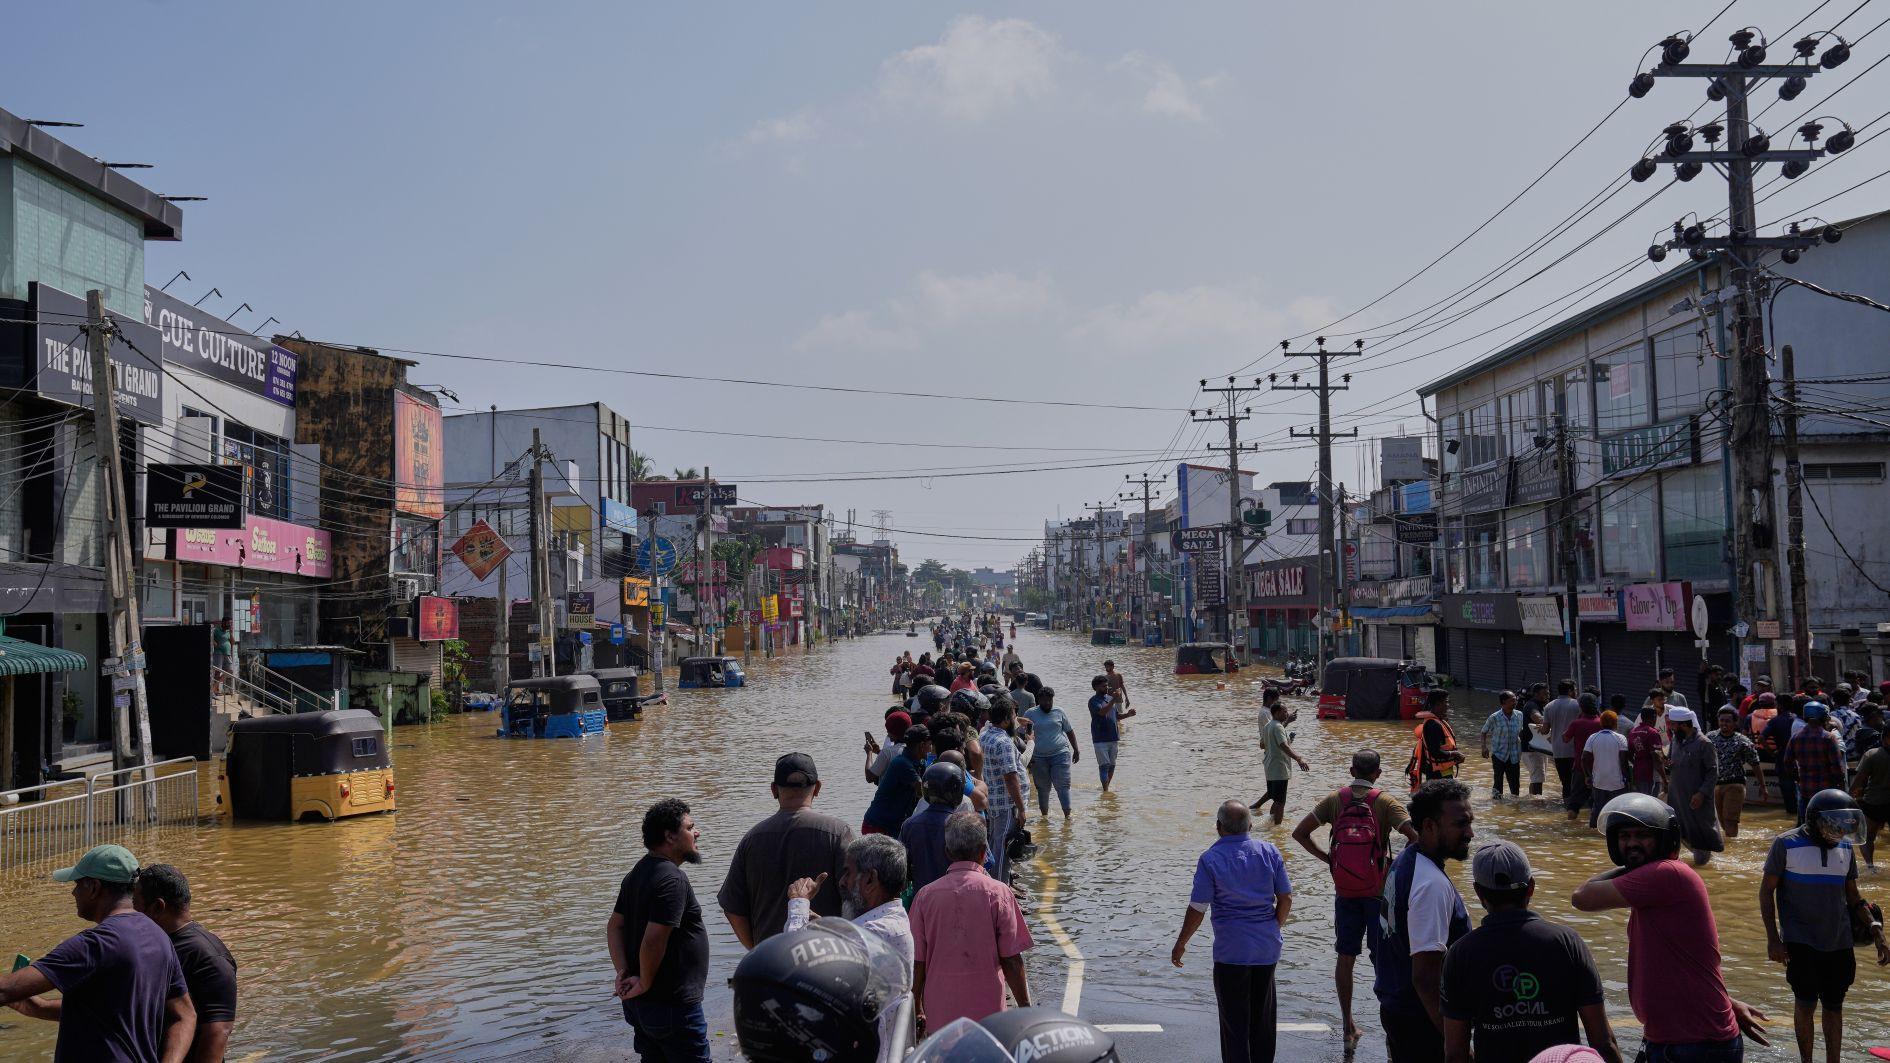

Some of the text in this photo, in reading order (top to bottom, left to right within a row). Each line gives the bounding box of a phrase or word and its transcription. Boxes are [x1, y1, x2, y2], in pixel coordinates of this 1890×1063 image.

[160, 308, 266, 382] CUE CULTURE
[46, 338, 69, 374] THE
[125, 364, 158, 399] GRAND
[271, 350, 297, 373] 12 NOON
[1608, 424, 1684, 471] MADAME
[1463, 468, 1500, 497] INFINITY
[154, 503, 235, 513] THE PAVILION GRAND
[1181, 530, 1215, 540] MEGA
[1254, 569, 1277, 597] MEGA
[1279, 567, 1304, 596] SALE
[573, 602, 590, 613] Eat
[1472, 603, 1494, 619] STORE
[569, 614, 593, 623] HOUSE
[1493, 1001, 1549, 1019] SOCIAL
[1543, 1016, 1565, 1026] BRAND
[1018, 1026, 1093, 1063] ACTION
